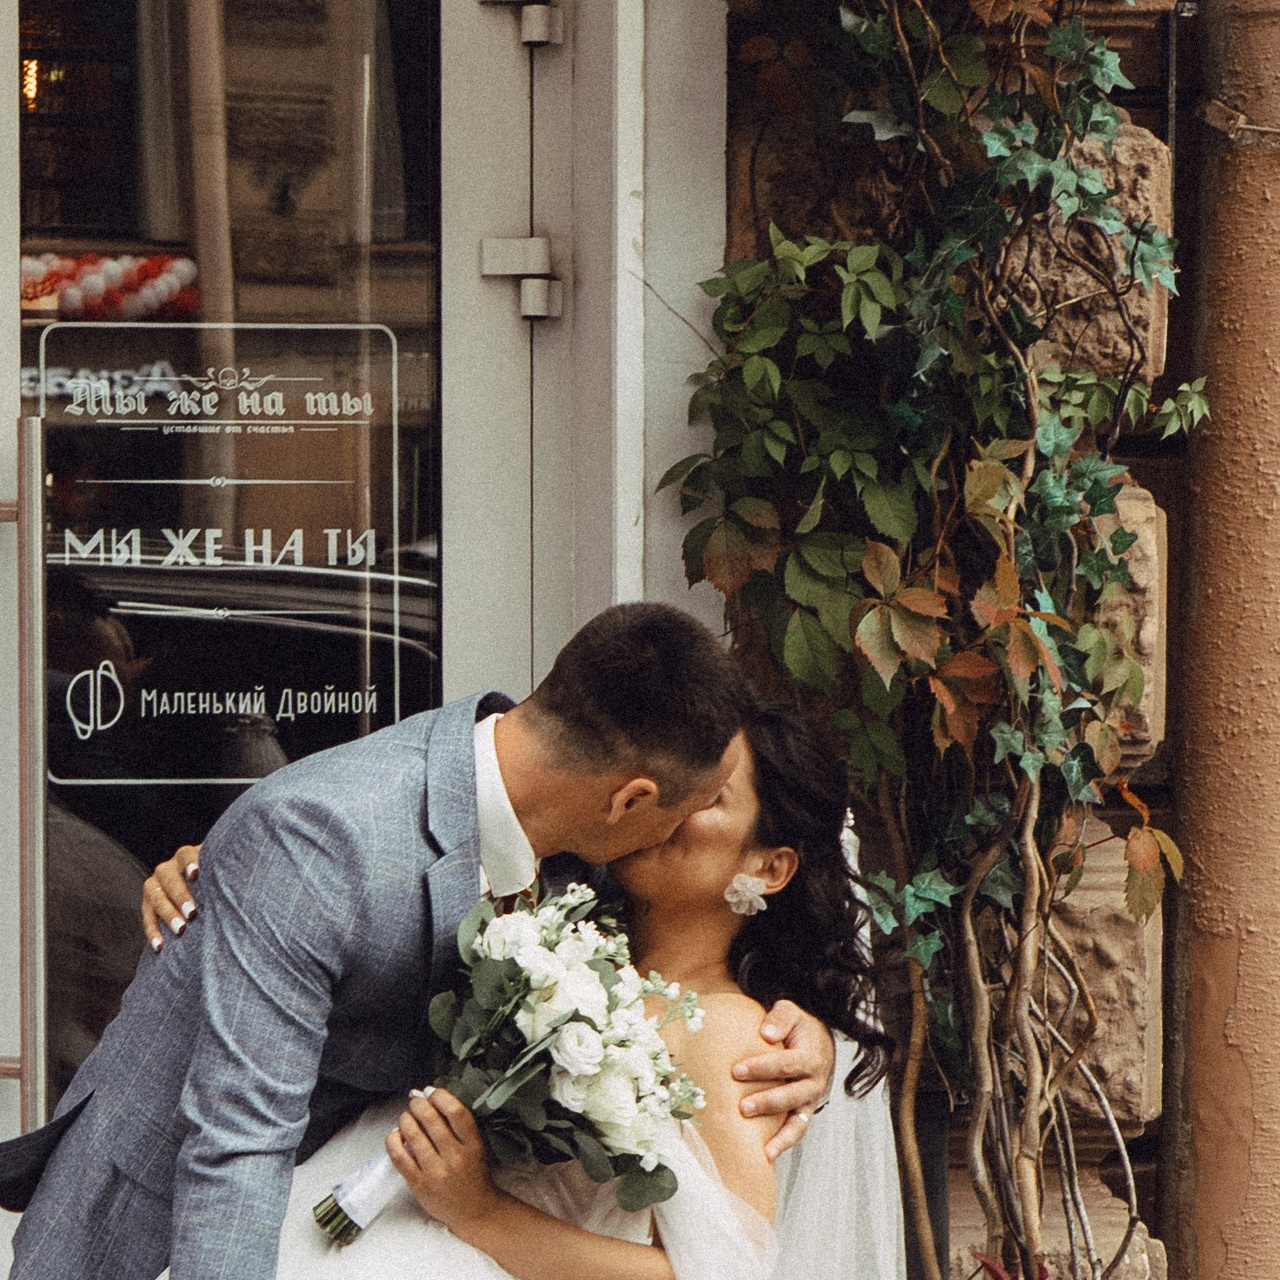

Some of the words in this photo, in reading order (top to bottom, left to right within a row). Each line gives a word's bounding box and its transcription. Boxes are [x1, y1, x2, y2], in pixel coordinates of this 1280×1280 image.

[64, 378, 150, 417] Мы
[167, 391, 220, 416] же
[237, 391, 287, 416] на
[306, 391, 375, 416] ты
[64, 528, 142, 566] МЫ
[160, 528, 224, 566] ЖЕ
[244, 528, 304, 567] НА
[323, 528, 376, 566] ТЫ
[141, 685, 266, 718] Маленький
[276, 684, 378, 721] Двойной
